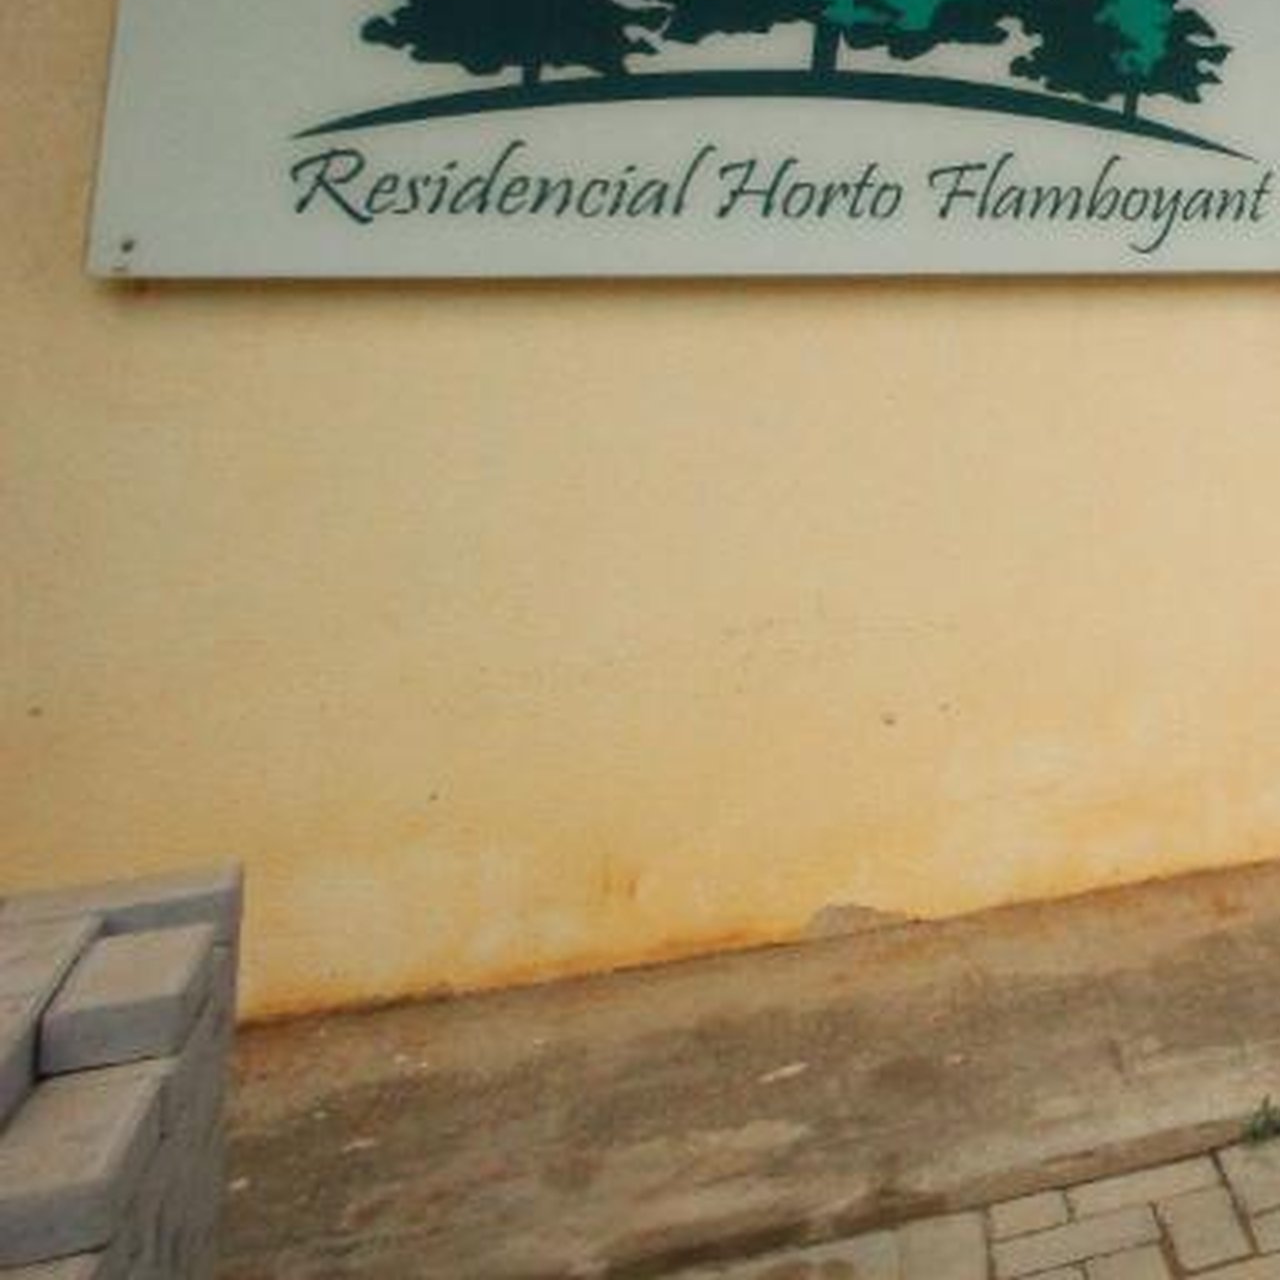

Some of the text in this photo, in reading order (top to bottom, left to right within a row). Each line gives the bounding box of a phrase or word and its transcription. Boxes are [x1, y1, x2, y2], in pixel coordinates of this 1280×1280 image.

[287, 139, 1273, 254] Residencial Horto Flamboyant
